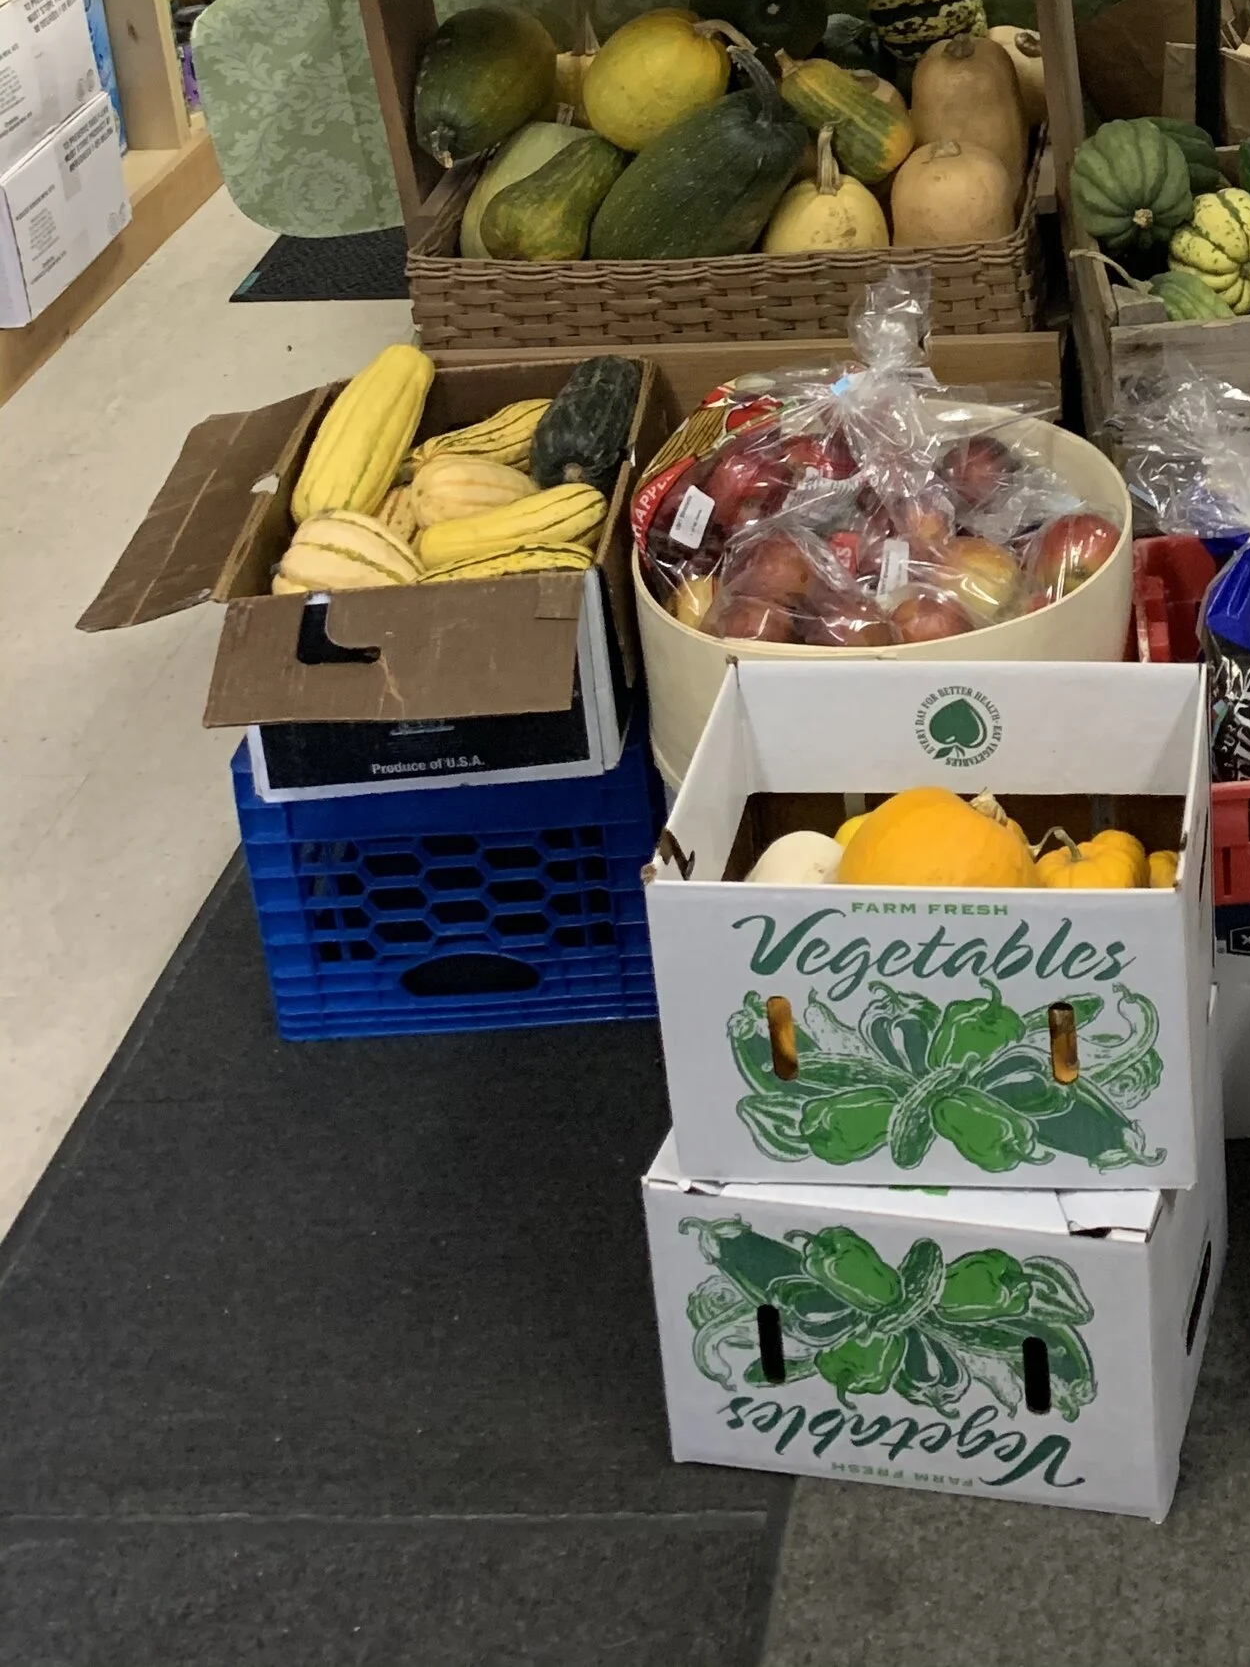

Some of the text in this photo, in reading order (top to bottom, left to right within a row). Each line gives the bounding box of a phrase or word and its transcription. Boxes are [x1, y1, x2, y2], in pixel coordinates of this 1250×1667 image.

[920, 693, 939, 709] FOR
[937, 685, 973, 697] BETTER
[914, 710, 927, 726] DAY
[914, 728, 936, 754] EVERY
[991, 725, 1003, 742] EAT
[371, 754, 485, 775] Produce of U.S.A.
[945, 742, 998, 767] VEGETABLES
[851, 901, 1009, 916] FARM FRESH
[732, 908, 1137, 1002] Vegetables
[717, 1396, 1086, 1488] Vegetables
[830, 1460, 974, 1488] FARM FRESH
